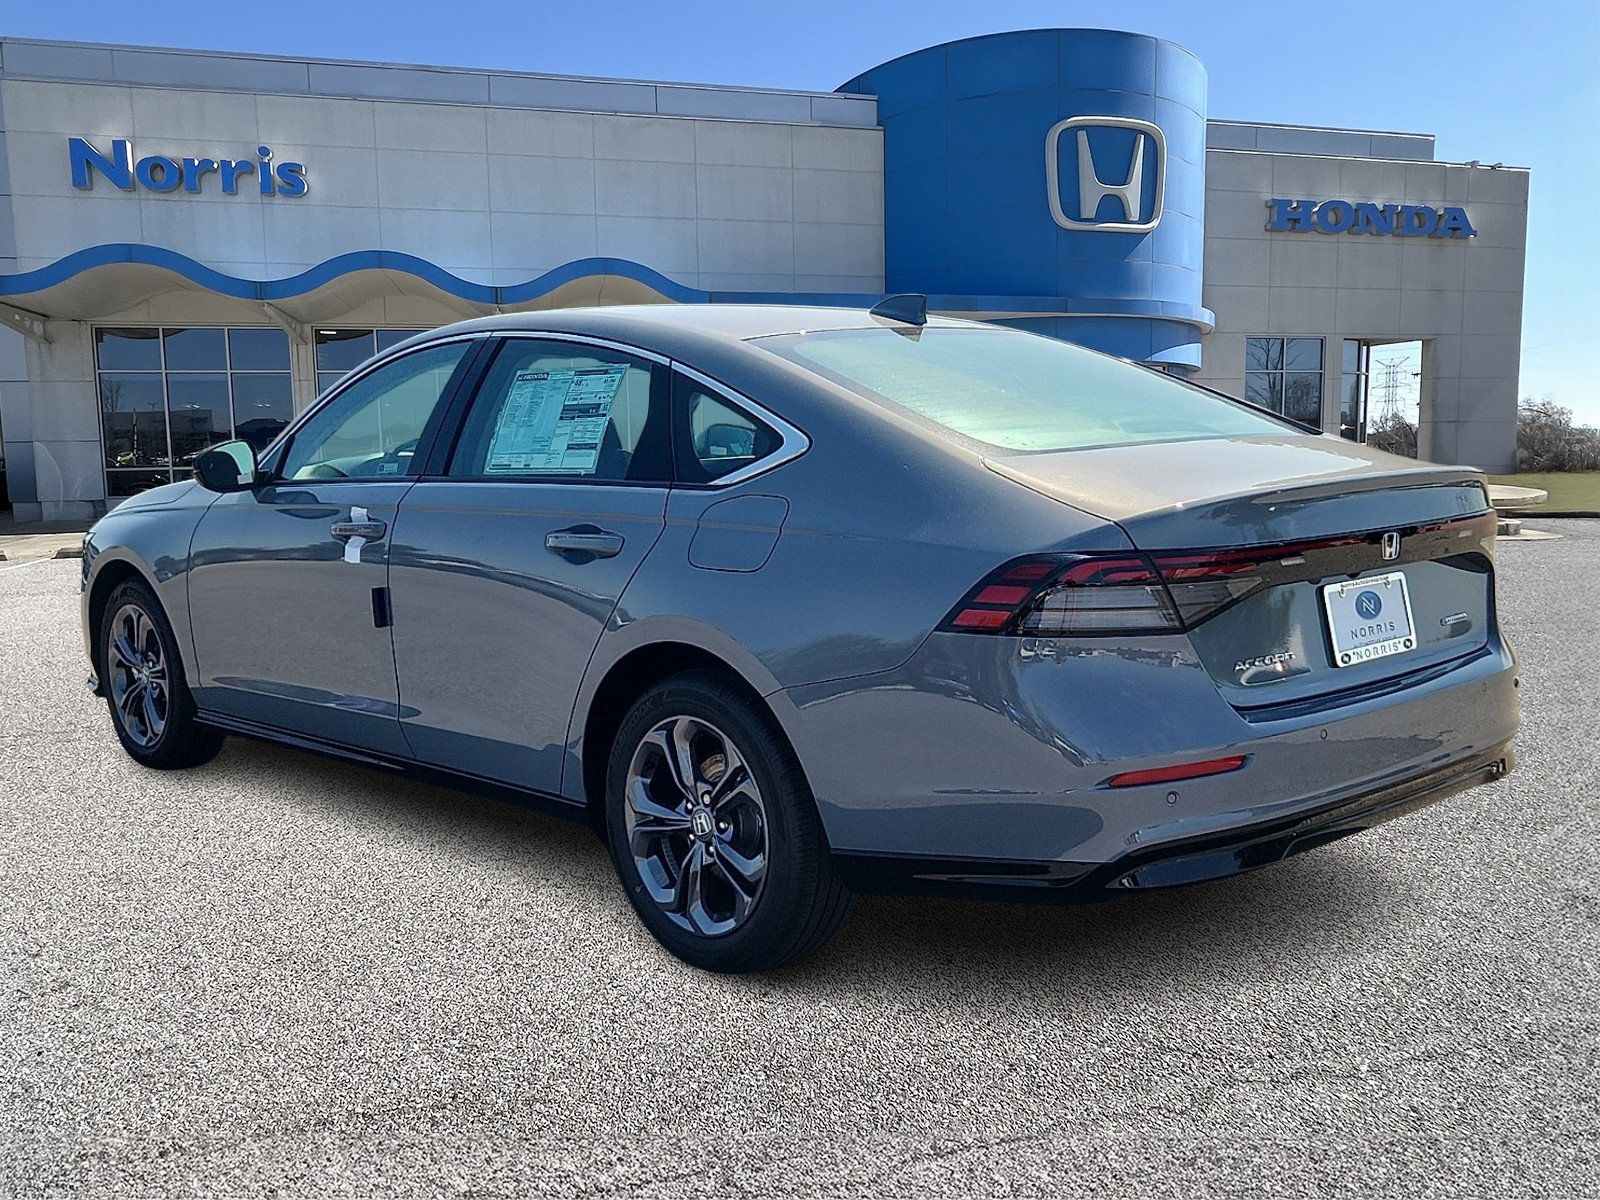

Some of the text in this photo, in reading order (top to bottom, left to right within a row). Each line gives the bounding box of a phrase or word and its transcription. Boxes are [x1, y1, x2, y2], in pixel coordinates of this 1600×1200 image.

[68, 137, 309, 198] Norris
[1265, 197, 1478, 238] HONDA
[1350, 621, 1396, 640] NORRIS
